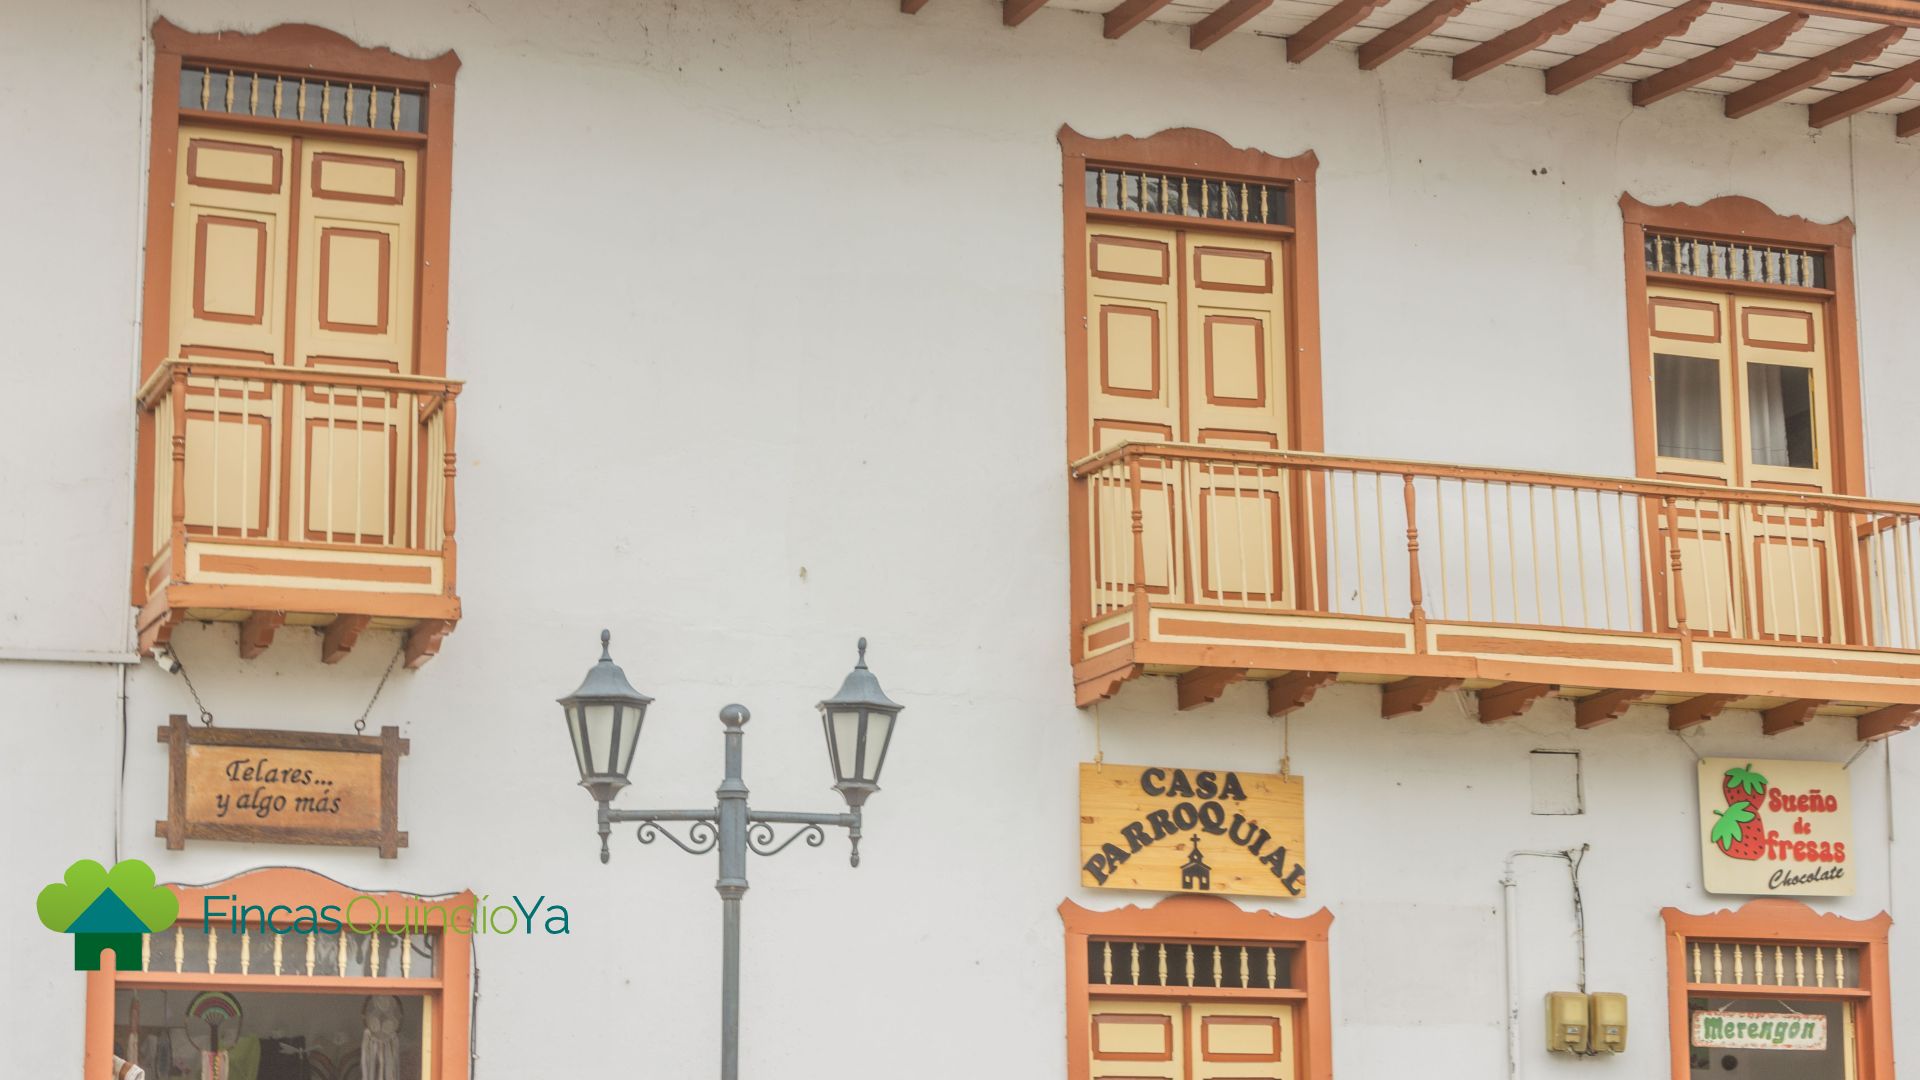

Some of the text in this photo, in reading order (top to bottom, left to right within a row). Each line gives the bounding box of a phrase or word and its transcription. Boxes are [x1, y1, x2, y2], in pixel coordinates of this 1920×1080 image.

[226, 759, 334, 786] Telares...
[1140, 767, 1247, 800] CASA
[215, 786, 341, 818] y algo más
[1768, 787, 1838, 813] Sueño
[1793, 817, 1811, 835] de
[1083, 801, 1306, 896] PARROQUIAL
[1765, 830, 1845, 863] fresas
[1768, 866, 1844, 890] Chocolate
[1703, 1016, 1816, 1044] Merengón
